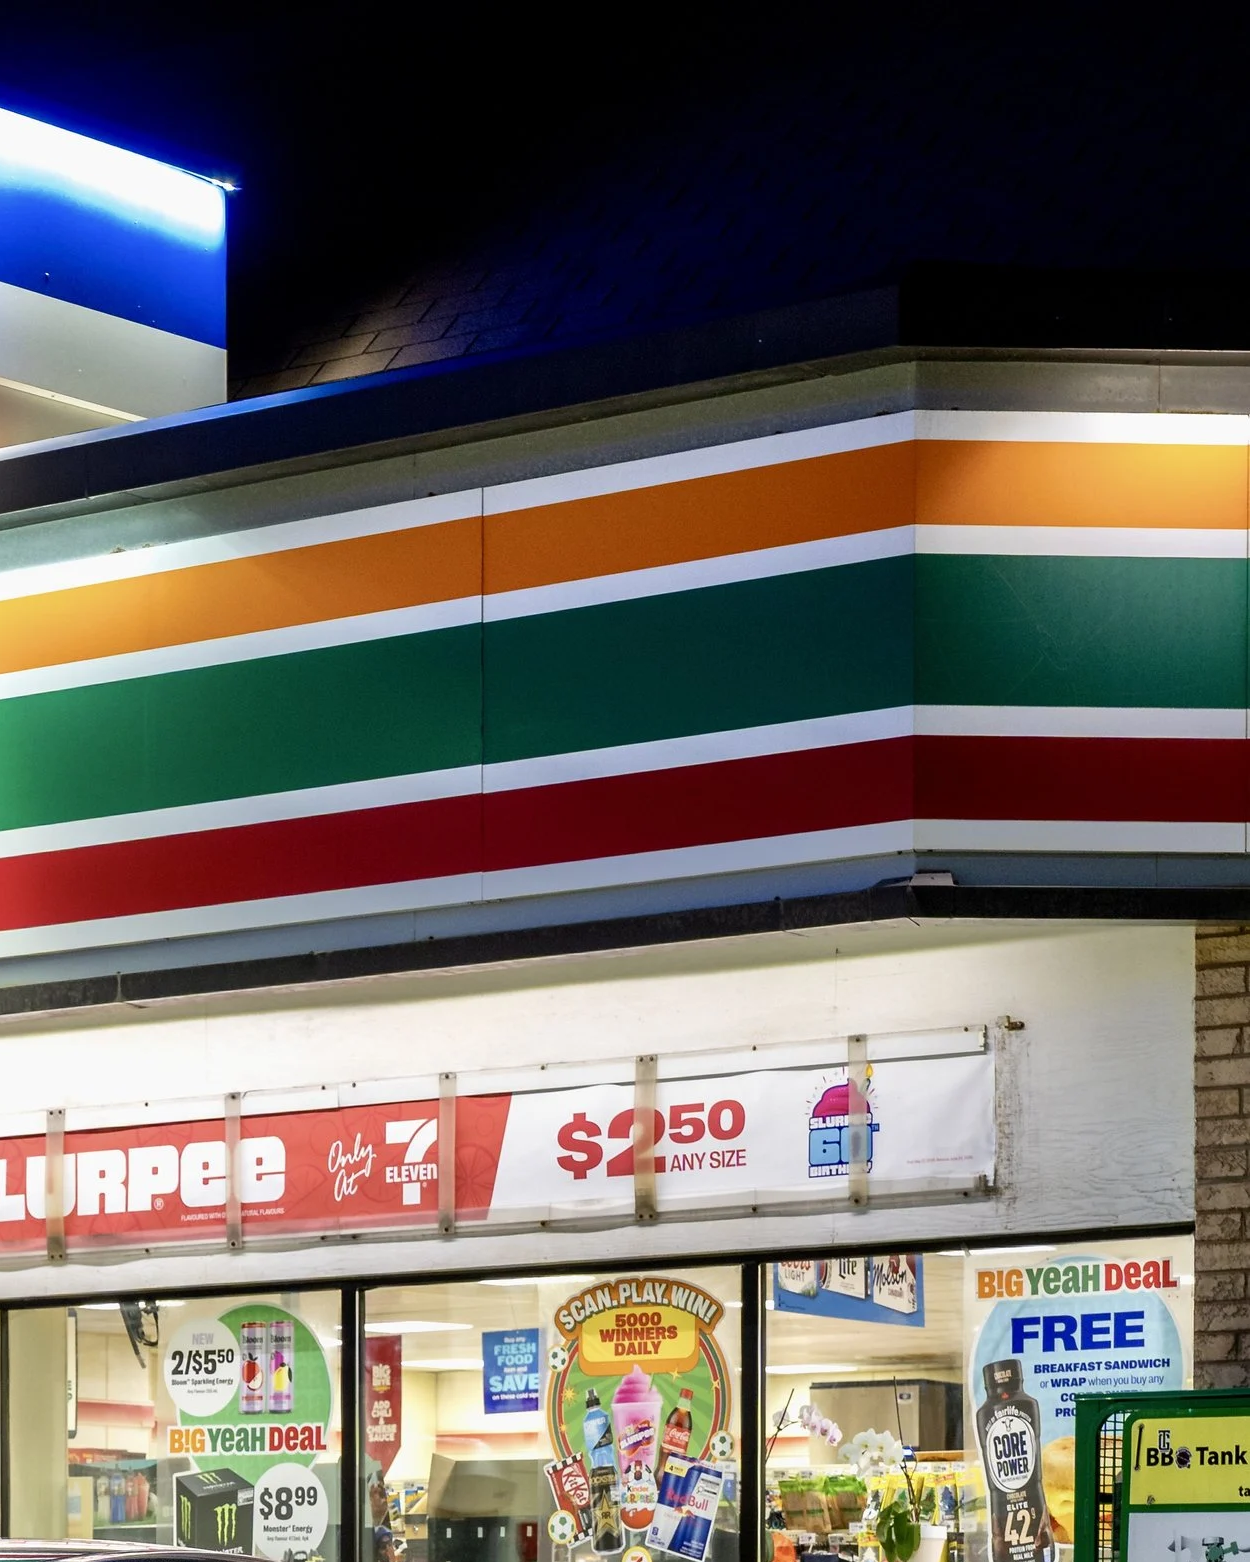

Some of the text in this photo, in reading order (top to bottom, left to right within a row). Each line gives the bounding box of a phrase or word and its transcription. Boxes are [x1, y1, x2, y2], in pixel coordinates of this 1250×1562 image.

[327, 1133, 377, 1177] Only
[385, 1118, 438, 1205] 7
[670, 1148, 747, 1173] ANY SIZE
[334, 1167, 361, 1201] At
[784, 1270, 805, 1282] LIGHT
[670, 1285, 718, 1323] WIN!
[615, 1312, 662, 1328] 5000
[192, 1333, 214, 1345] NEW
[599, 1325, 678, 1342] WINNERS
[1011, 1310, 1145, 1354] FREE
[494, 1342, 536, 1355] FRESH
[614, 1341, 662, 1356] DAILY
[497, 1354, 533, 1366] FOOD
[1034, 1358, 1171, 1374] BREAKFAST SANDWICH
[191, 1378, 215, 1386] Sparkling
[216, 1378, 234, 1386] Energy
[489, 1373, 539, 1392] SAVE
[1040, 1374, 1165, 1389] or WRAP when you buy any
[993, 1431, 1028, 1460] CORE
[1196, 1445, 1248, 1466] Tank
[996, 1456, 1029, 1478] POWER
[687, 1495, 709, 1511] Bull
[1006, 1501, 1028, 1512] ELITE
[263, 1525, 313, 1534] Monster Energy
